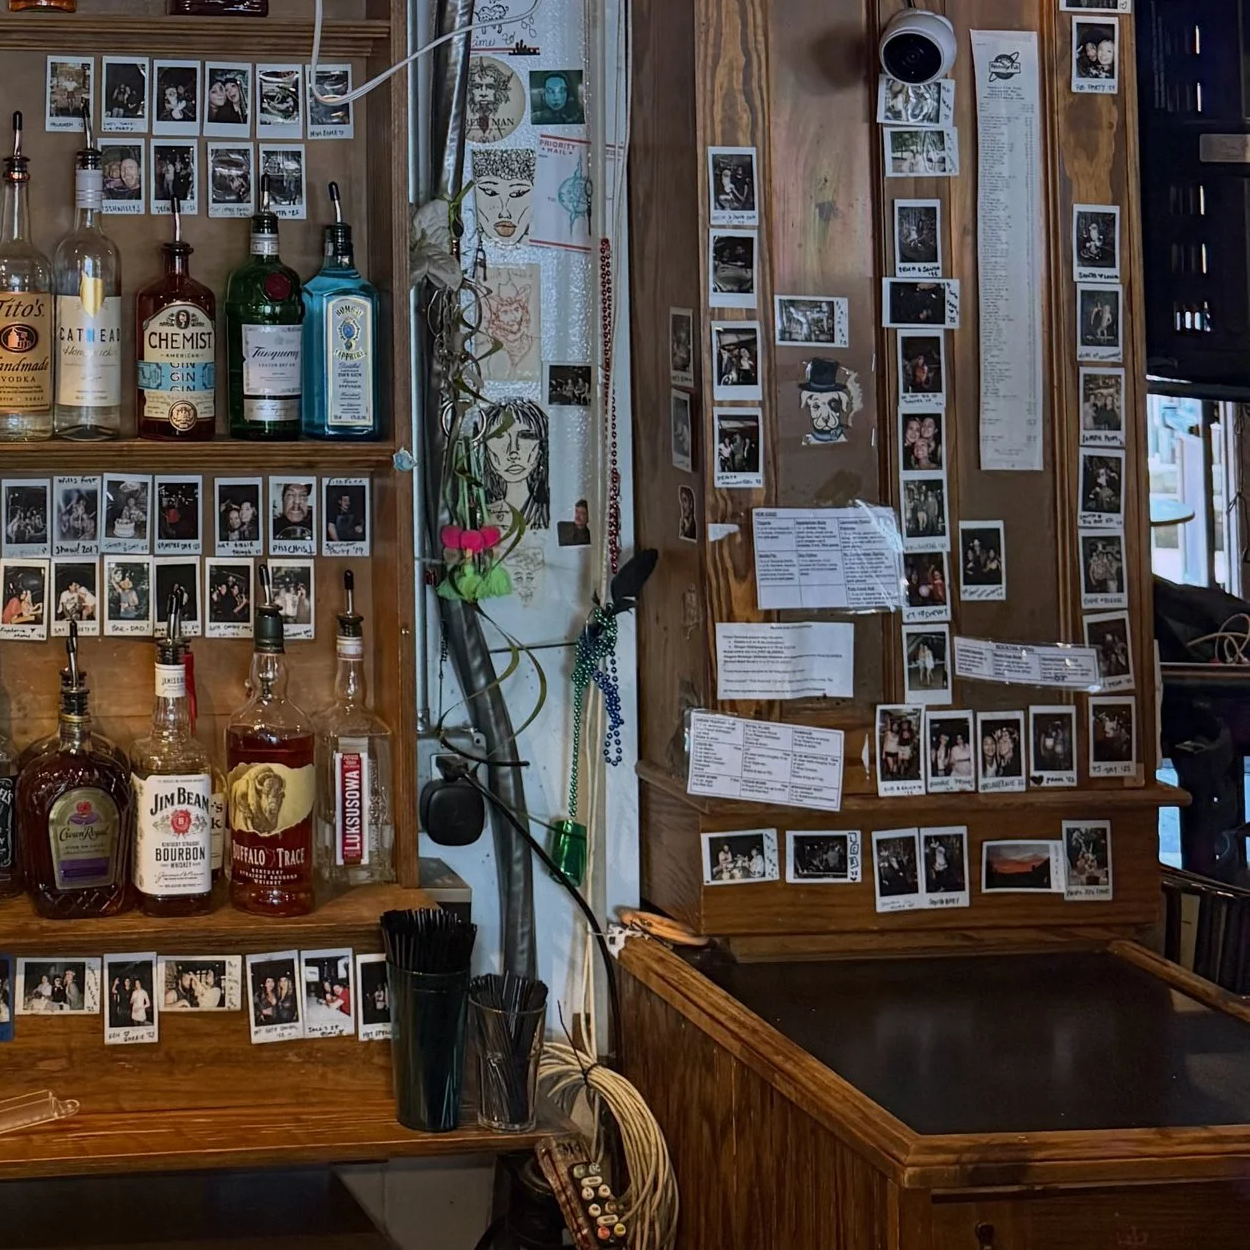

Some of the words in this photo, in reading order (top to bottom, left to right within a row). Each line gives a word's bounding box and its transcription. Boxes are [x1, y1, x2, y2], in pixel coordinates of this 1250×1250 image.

[492, 117, 515, 127] MAN
[538, 139, 577, 150] PRIORITY
[547, 147, 567, 156] MAIL
[148, 330, 213, 349] CHEMIST
[251, 346, 299, 361] Tanqueray
[0, 375, 37, 383] VODKA
[169, 371, 197, 383] GIN
[150, 793, 175, 816] JIM
[344, 770, 361, 852] LUKSUSOWA
[59, 828, 87, 843] Crown
[85, 825, 111, 844] Royal
[155, 847, 206, 862] BOURBON
[232, 839, 266, 866] BUFFALO
[276, 847, 305, 868] TRACE
[170, 861, 192, 869] WHISKEY
[251, 867, 284, 875] KENTUCKY
[253, 878, 282, 886] WHISKEY
